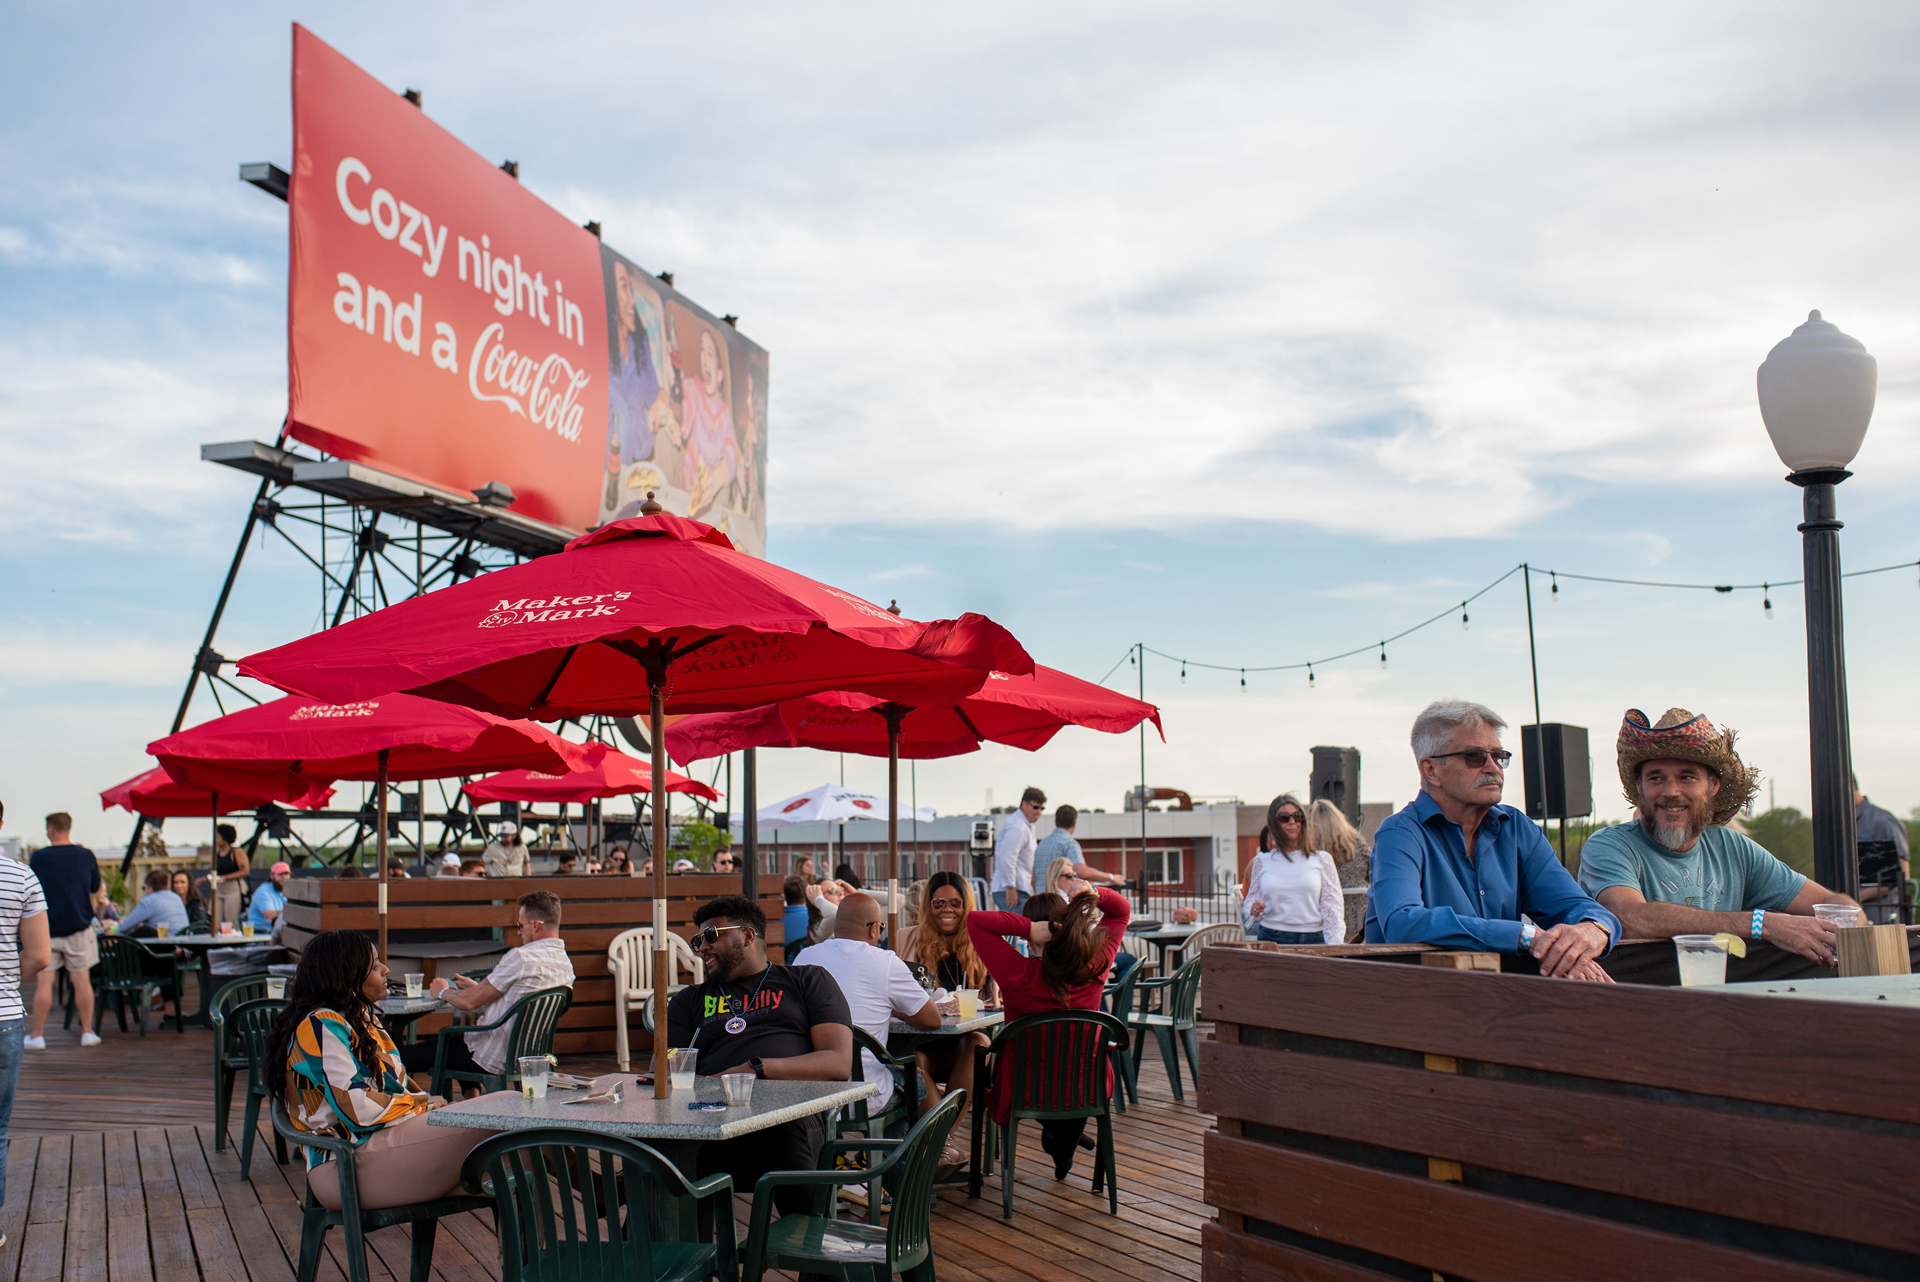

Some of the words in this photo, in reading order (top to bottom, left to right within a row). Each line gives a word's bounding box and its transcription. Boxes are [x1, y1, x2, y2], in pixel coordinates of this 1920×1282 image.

[335, 156, 449, 278] Cozy
[457, 234, 551, 327] night
[555, 279, 585, 347] in
[333, 272, 423, 357] and
[431, 321, 459, 375] a
[468, 321, 592, 443] Coca-Cola
[489, 590, 632, 612] Maker's
[513, 604, 618, 625] Mark
